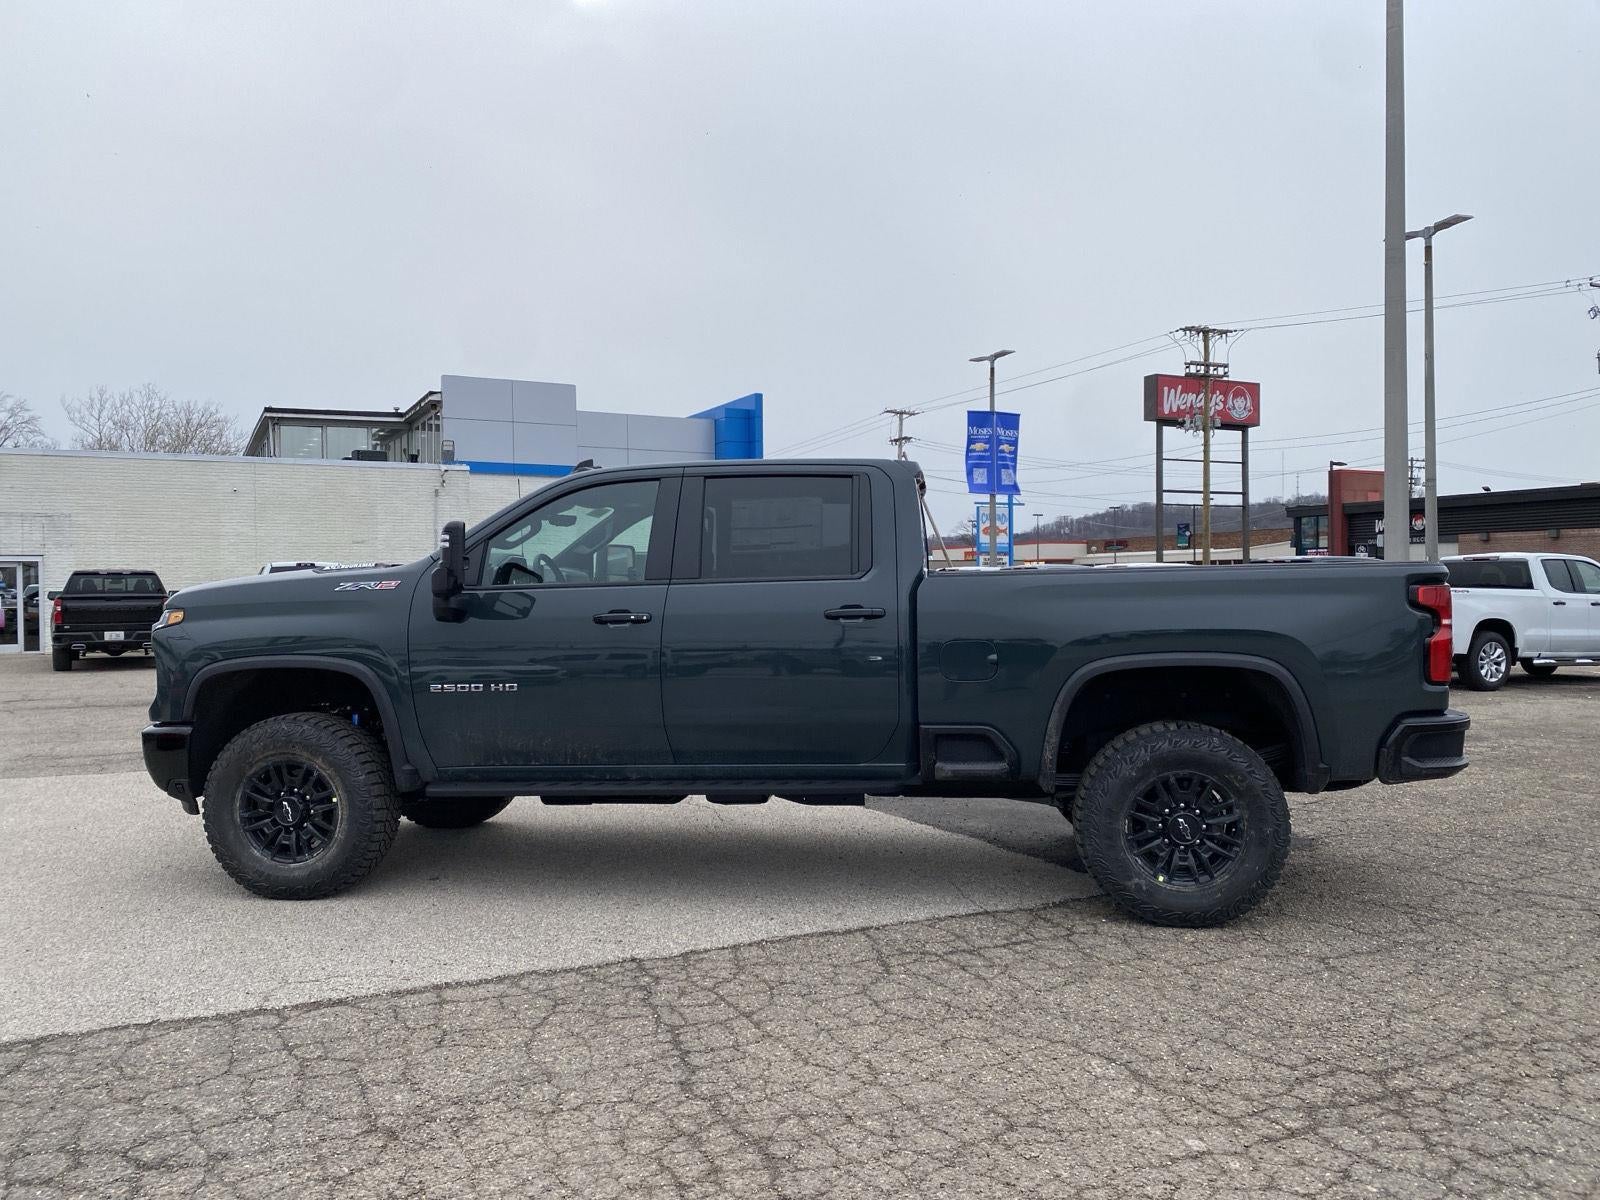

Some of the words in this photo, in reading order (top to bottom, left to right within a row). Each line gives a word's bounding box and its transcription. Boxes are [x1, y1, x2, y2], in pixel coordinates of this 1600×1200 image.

[968, 426, 992, 435] MOSES
[334, 580, 401, 591] ZR2
[429, 683, 484, 692] 2500
[490, 683, 518, 692] HD
